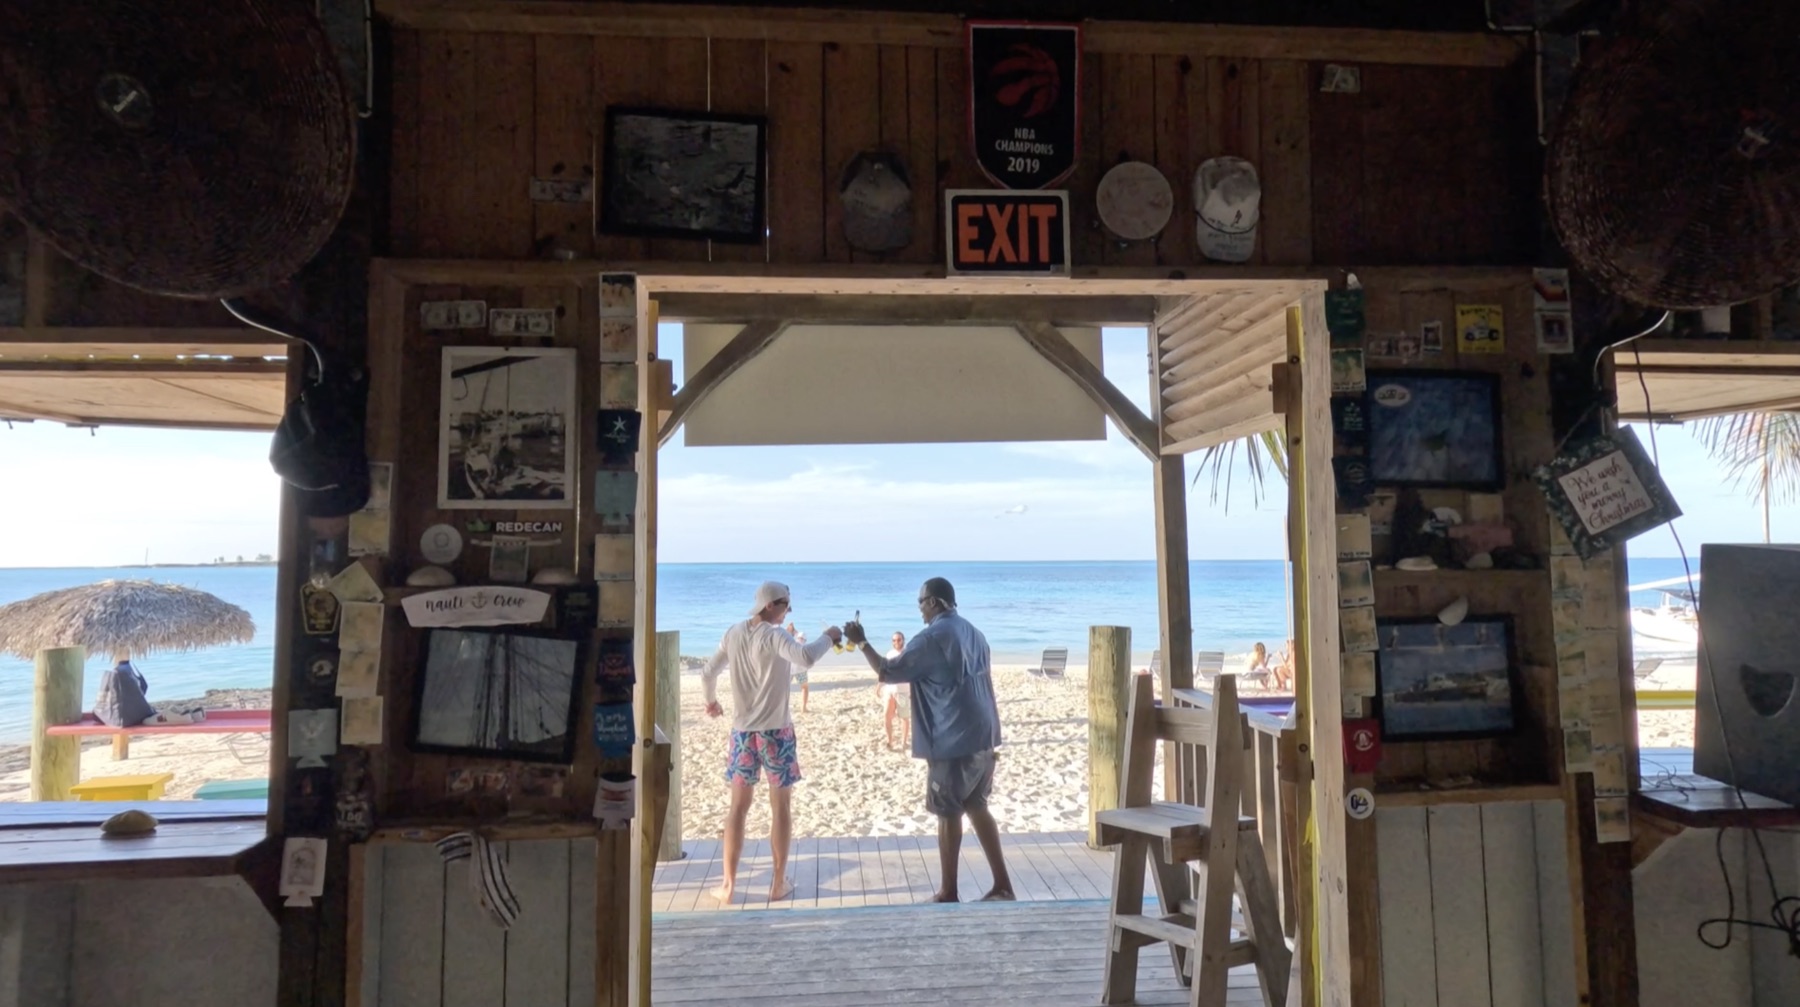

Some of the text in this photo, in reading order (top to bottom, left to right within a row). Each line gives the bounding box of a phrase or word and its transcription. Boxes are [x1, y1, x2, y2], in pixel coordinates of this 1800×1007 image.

[1014, 127, 1036, 140] NBA
[994, 139, 1054, 156] CHAMPIONS
[1007, 156, 1040, 174] 2019
[957, 202, 1058, 264] EXIT
[1568, 457, 1622, 492] We wish
[1577, 481, 1611, 510] you a
[1591, 487, 1627, 510] merry
[1589, 497, 1648, 530] Christmas
[495, 521, 563, 533] REDECAN
[425, 594, 527, 612] nauti crew
